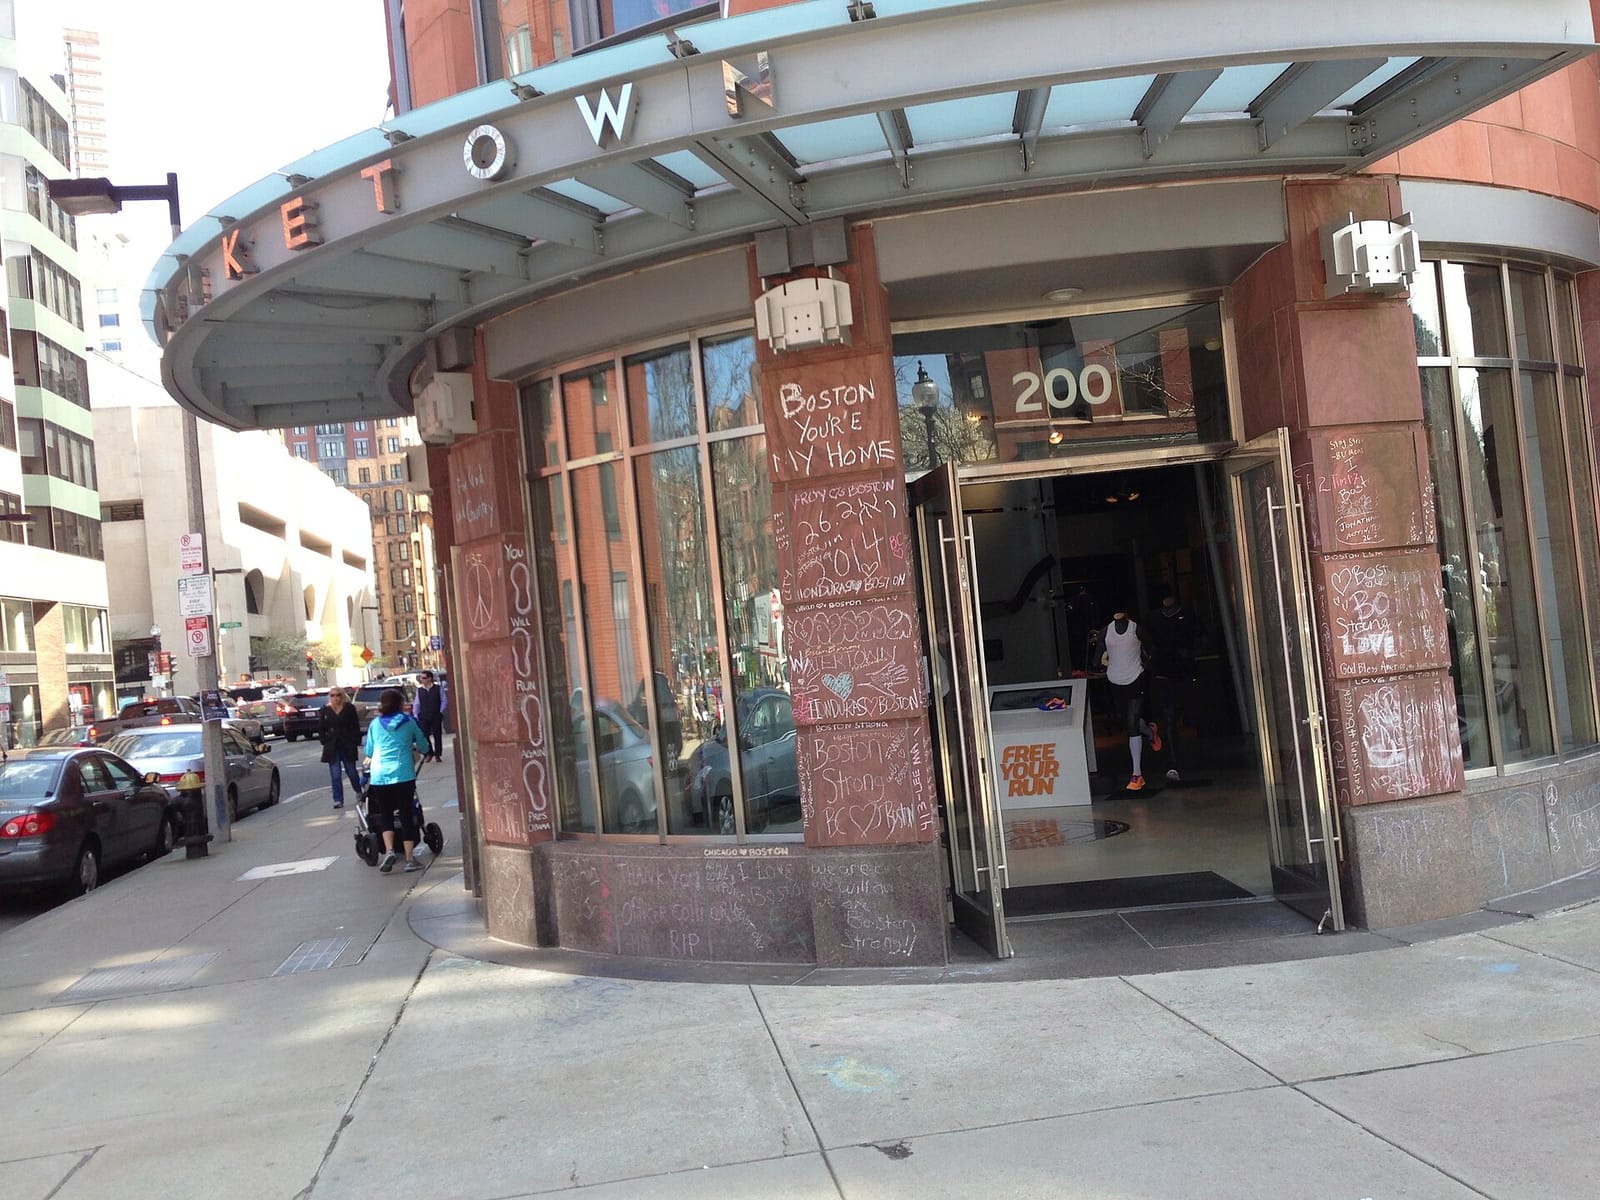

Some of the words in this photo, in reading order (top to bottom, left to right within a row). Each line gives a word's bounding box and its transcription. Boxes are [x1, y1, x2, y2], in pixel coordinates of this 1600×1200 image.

[779, 379, 876, 419] BOSTON
[1012, 364, 1112, 413] 200
[772, 445, 815, 476] MY
[826, 440, 896, 468] HOME
[848, 479, 895, 497] BOSTON
[797, 578, 851, 600] HONDURAS
[864, 573, 906, 592] BOSTON
[1342, 631, 1398, 659] LOVE
[1339, 662, 1356, 676] God
[1358, 663, 1378, 675] Bless
[1355, 676, 1385, 686] LOVE
[816, 722, 852, 732] BOSTON
[854, 722, 888, 730] STRONG
[814, 738, 884, 771] Boston
[1002, 743, 1056, 763] FREE
[1000, 760, 1060, 780] YOUR
[822, 767, 885, 804] Strong
[1008, 778, 1054, 797] RUN
[703, 848, 738, 856] CHICAGO
[748, 847, 789, 856] BOSTON
[670, 929, 701, 957] RIP
